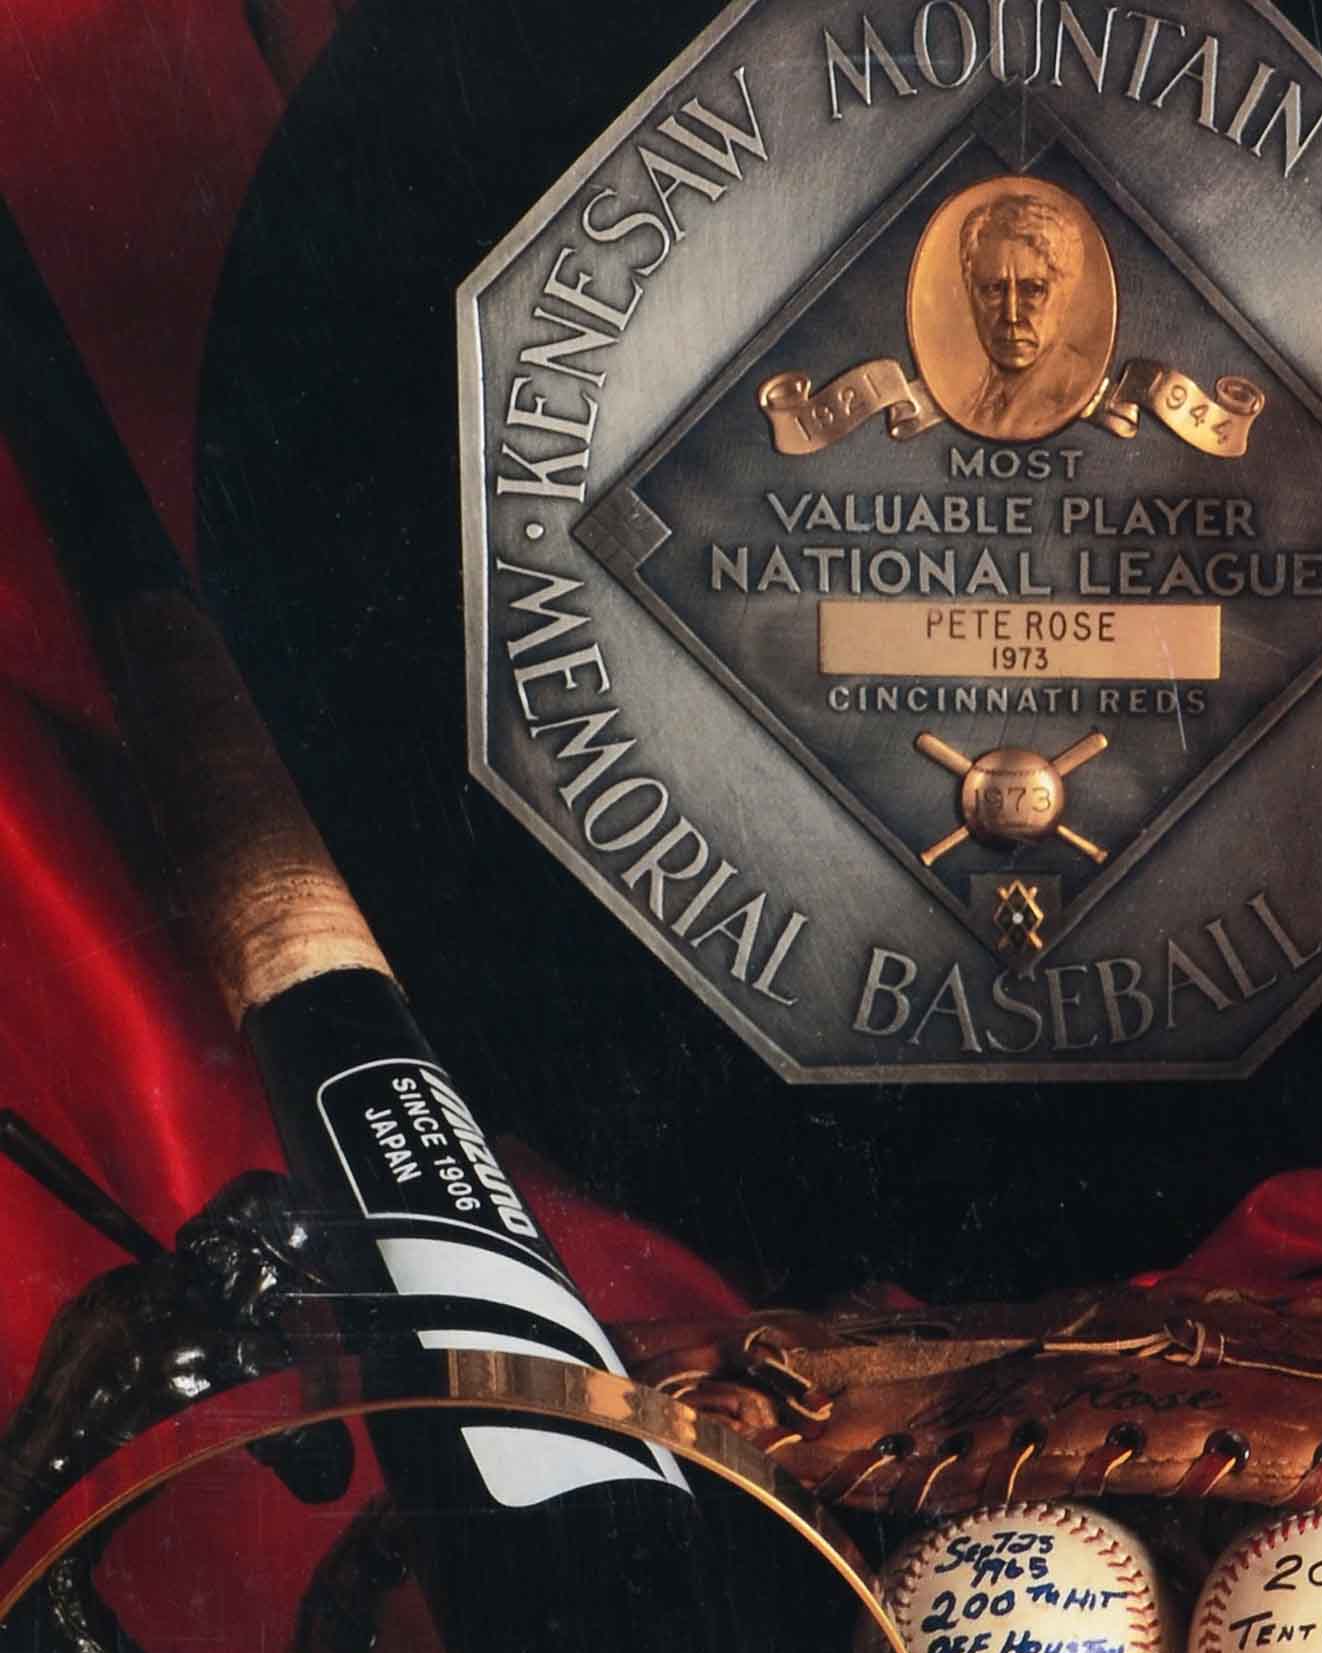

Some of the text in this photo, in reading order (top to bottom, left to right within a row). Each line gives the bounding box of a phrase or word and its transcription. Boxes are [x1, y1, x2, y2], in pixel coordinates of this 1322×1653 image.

[496, 66, 774, 507] KENESAW
[951, 447, 1083, 480] MOST
[767, 492, 1255, 537] VALUABLE PLAYER
[711, 547, 1051, 597] NATIONAL
[926, 609, 1116, 642] PETE ROSE
[991, 647, 1048, 670] 1973
[829, 686, 1206, 714] CINCINNATI REDS
[496, 558, 806, 1006] MEMORIAL
[973, 787, 1052, 813] 1973
[364, 1107, 422, 1183] JAPAN
[392, 1077, 481, 1212] SINCE 1906
